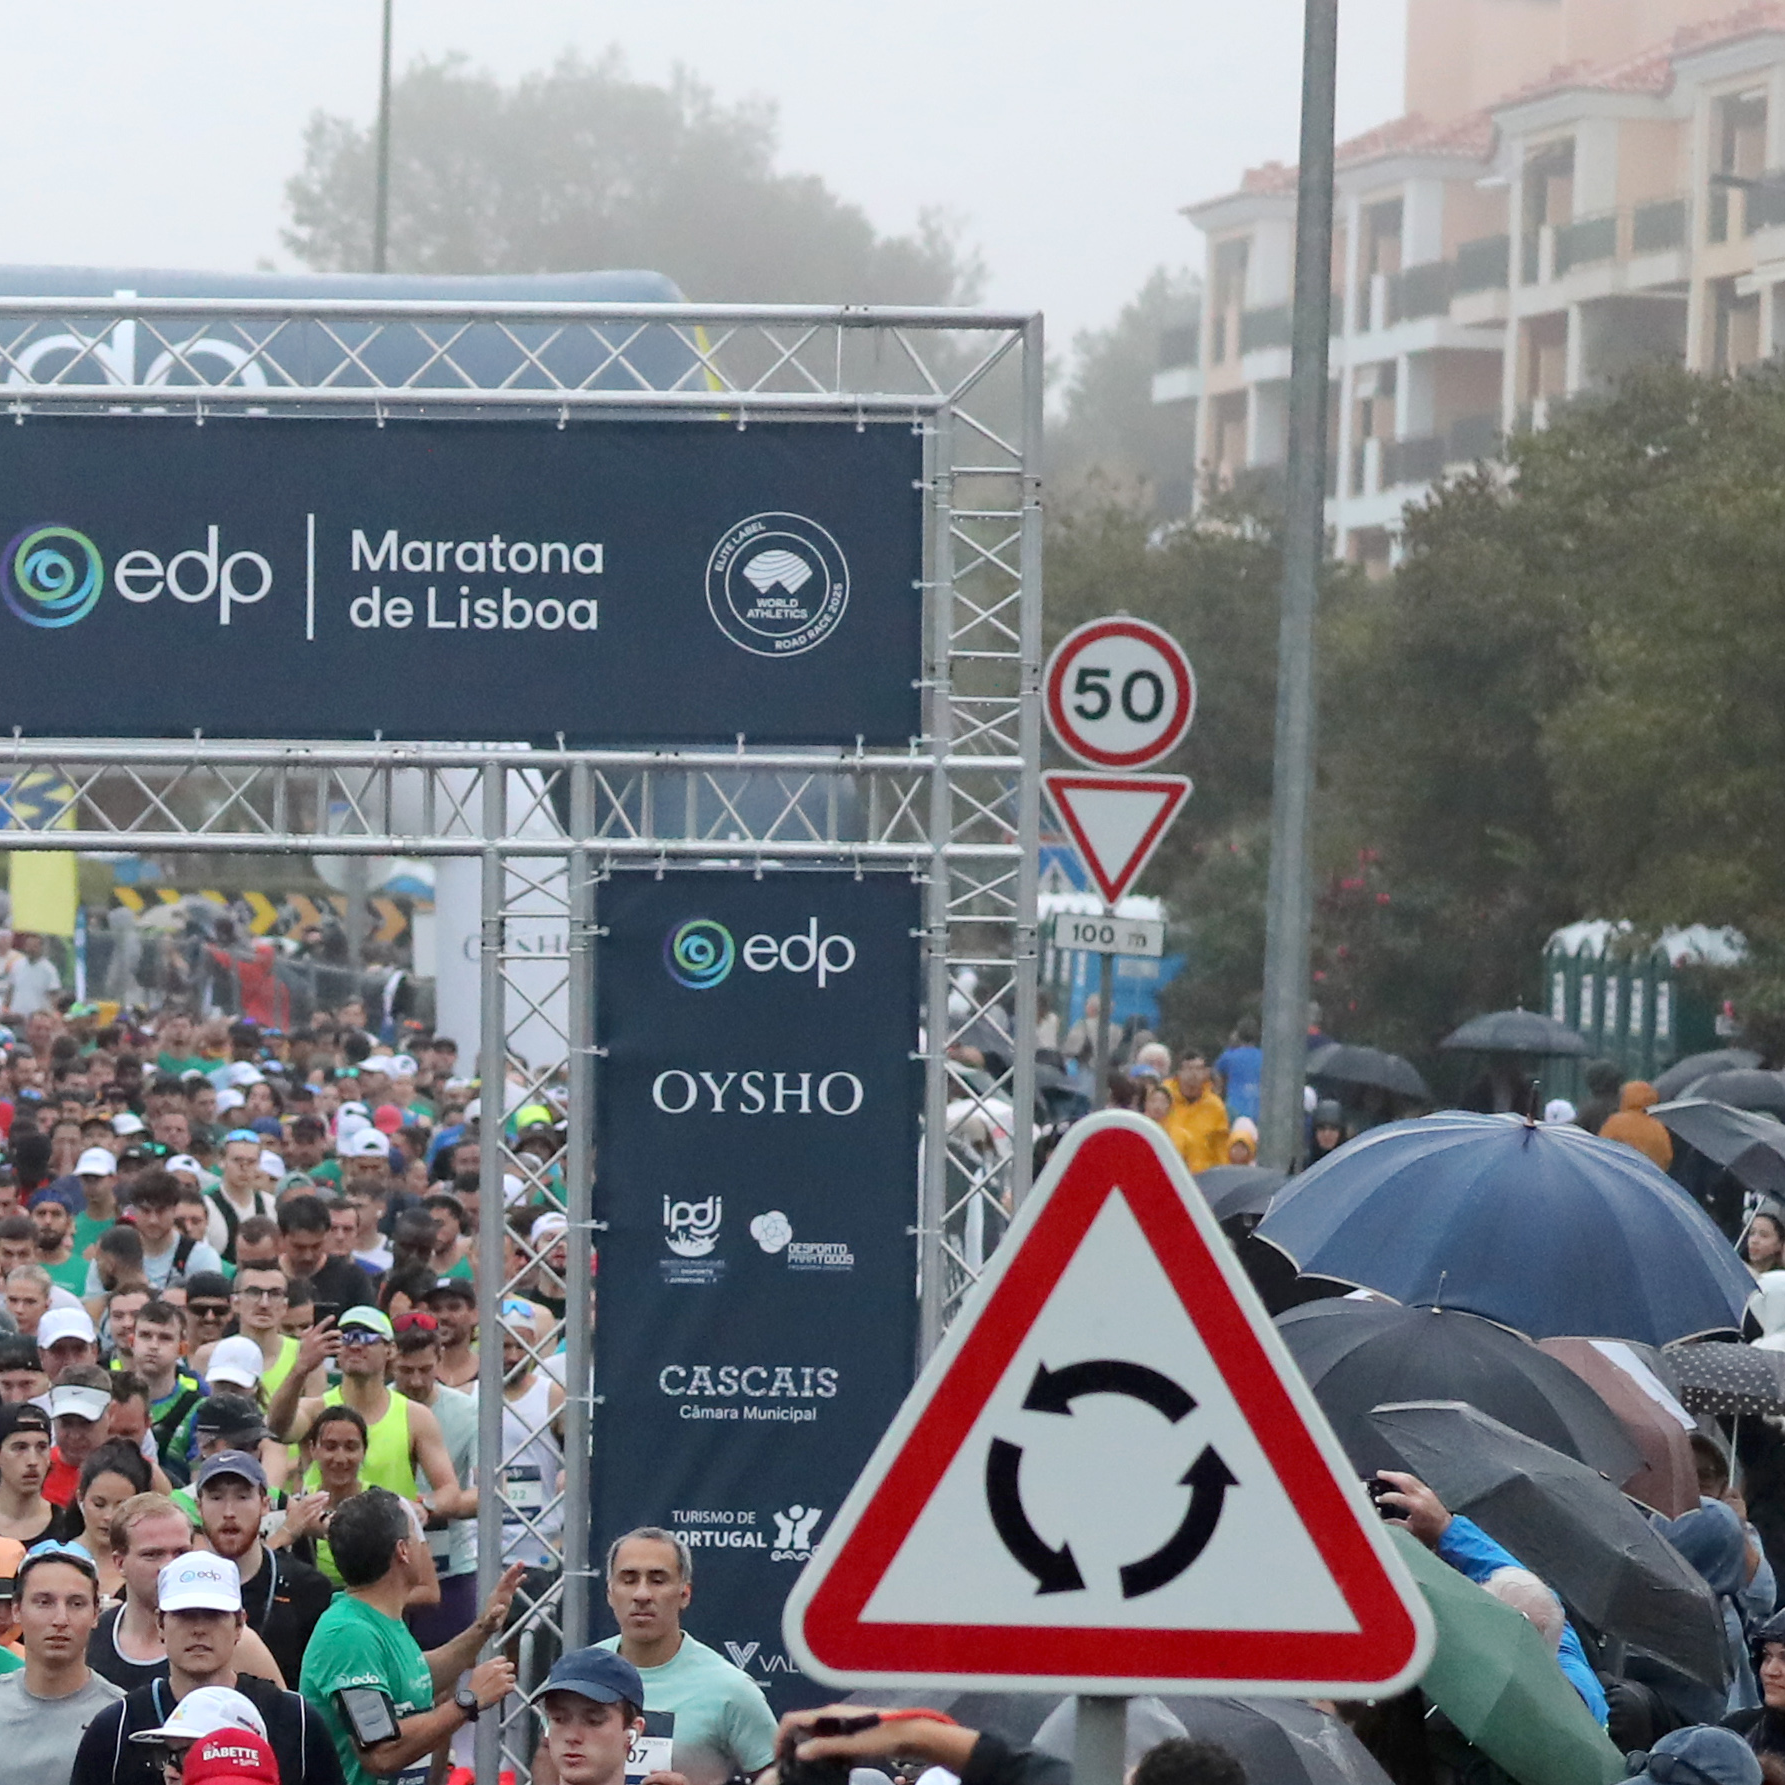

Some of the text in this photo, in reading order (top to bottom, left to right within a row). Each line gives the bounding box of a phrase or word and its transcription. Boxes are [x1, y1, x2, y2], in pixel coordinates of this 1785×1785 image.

[733, 521, 766, 544] LABEL
[351, 529, 604, 574] Maratona
[114, 525, 272, 625] edp
[350, 585, 598, 630] de Lisboa
[747, 609, 808, 618] ATHLETICS
[757, 598, 798, 608] WORLD
[775, 583, 843, 649] ROAD RACE 2025
[1074, 668, 1165, 723] 50
[1073, 923, 1115, 944] 100
[742, 917, 856, 988] edp
[652, 1070, 864, 1115] OYSHO
[788, 1242, 848, 1253] DESPORTO
[659, 1365, 839, 1398] CASCAIS
[680, 1405, 817, 1423] Câmara Municipal
[673, 1511, 756, 1525] TURISMO DE
[195, 1569, 221, 1582] edp
[202, 1746, 259, 1761] BABETTE
